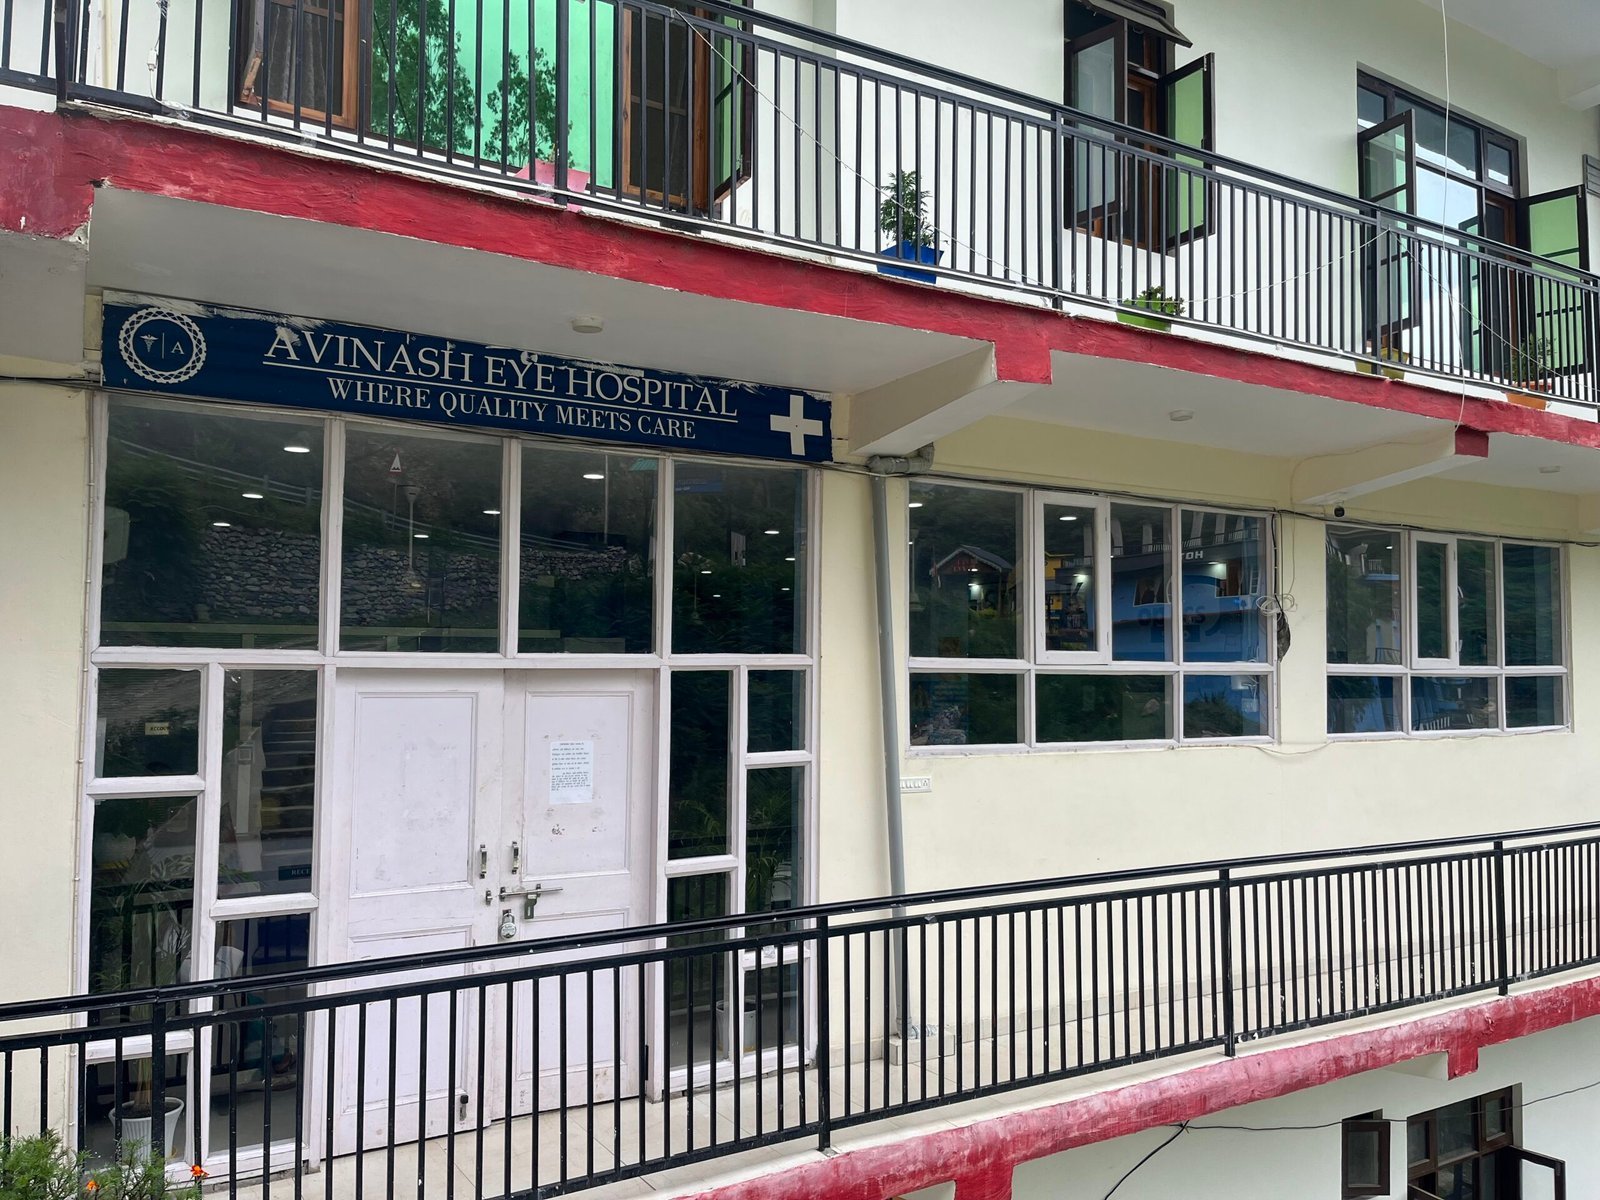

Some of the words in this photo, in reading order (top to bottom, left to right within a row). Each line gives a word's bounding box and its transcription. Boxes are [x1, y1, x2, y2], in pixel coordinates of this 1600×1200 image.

[170, 341, 185, 355] A
[264, 330, 474, 382] AVINASH
[484, 355, 556, 393] EYE
[565, 367, 738, 417] HOSPITAL
[326, 377, 431, 409] WHERE
[439, 391, 549, 422] QUALITY
[556, 404, 632, 432] MEETS
[638, 415, 696, 440] CARE
